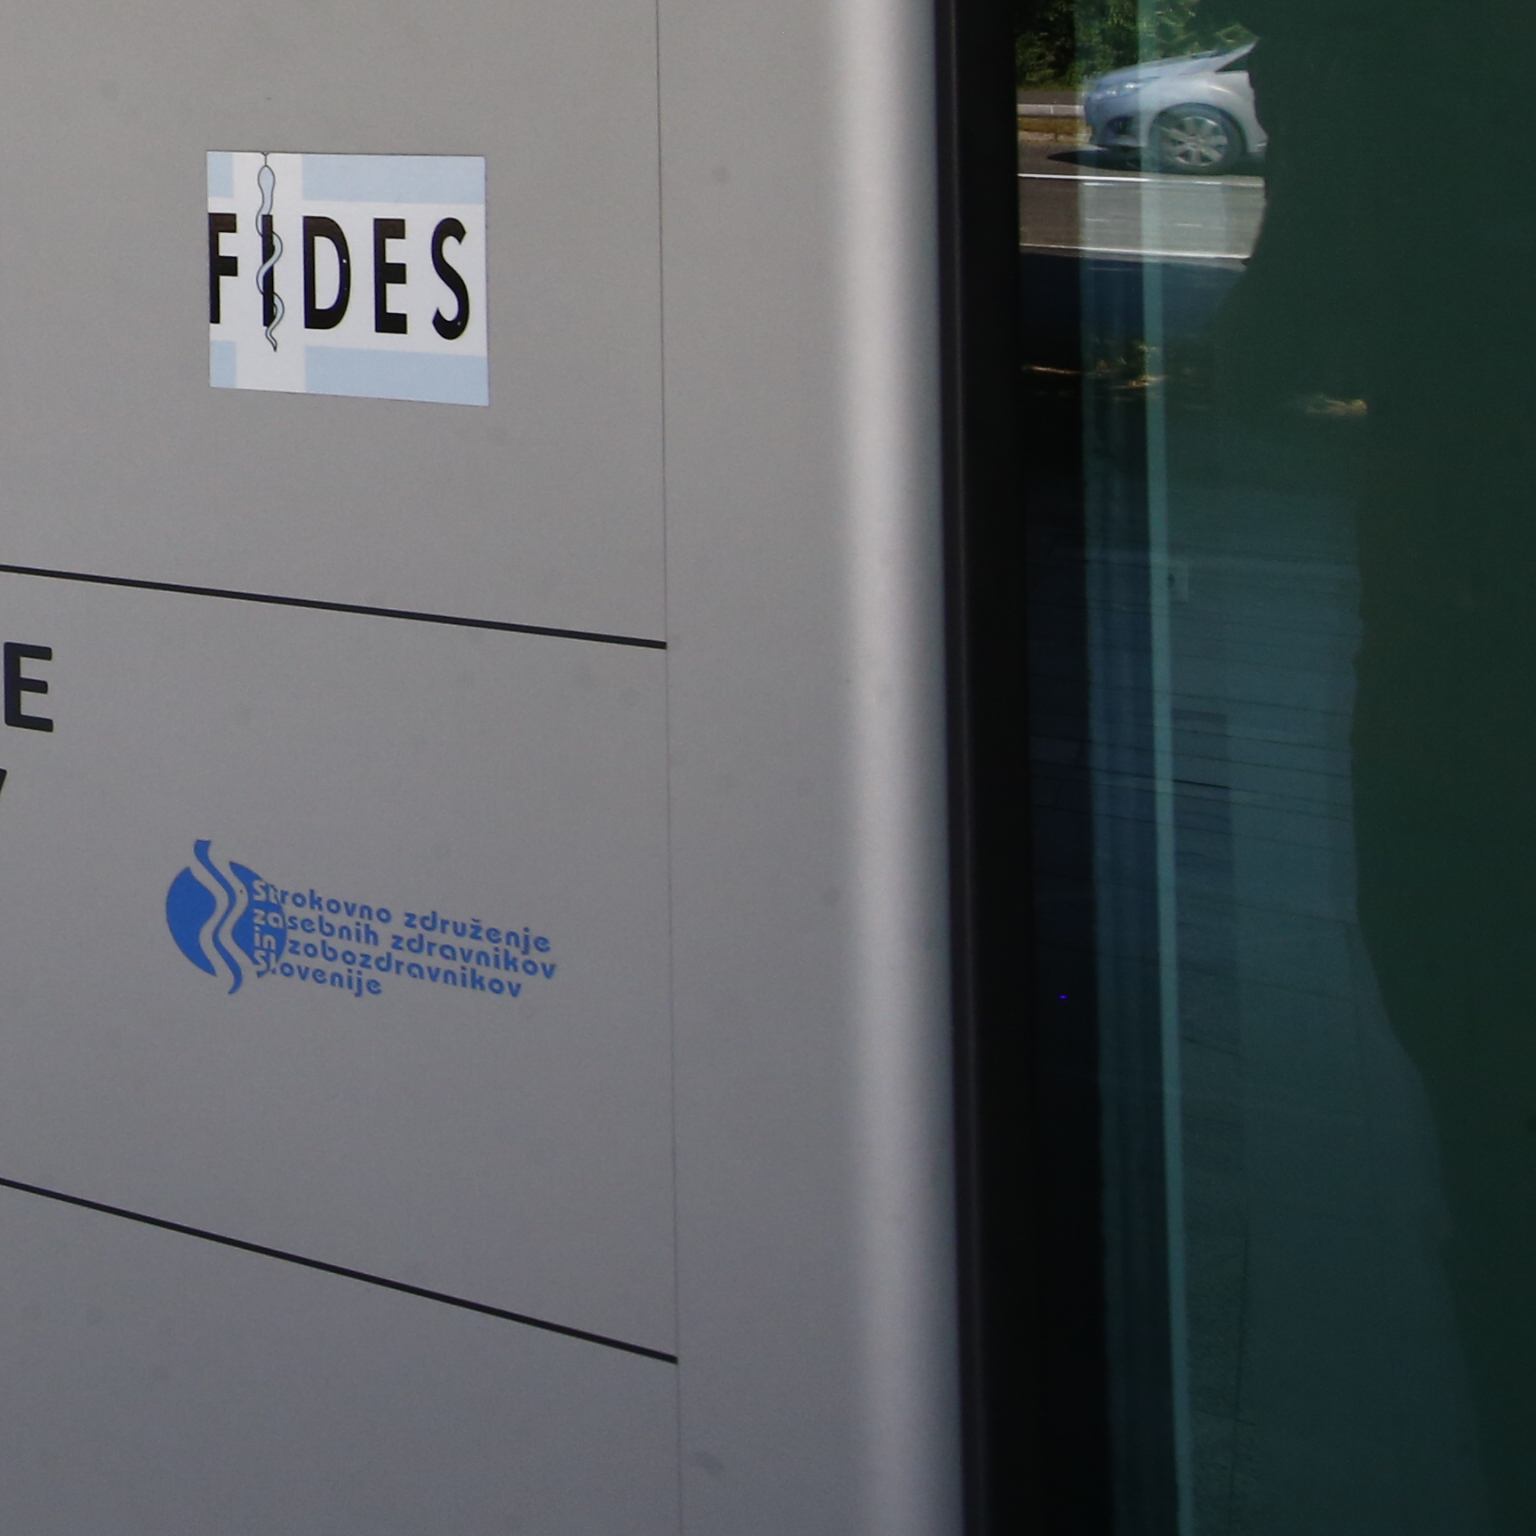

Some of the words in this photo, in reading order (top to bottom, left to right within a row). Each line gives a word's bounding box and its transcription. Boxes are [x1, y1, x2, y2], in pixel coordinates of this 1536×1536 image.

[208, 212, 470, 341] FIDES
[253, 879, 392, 923] Strokovno
[404, 911, 551, 955] združenje
[254, 908, 379, 946] zasebnih
[391, 933, 557, 979] zdravnikov
[254, 926, 277, 950] in
[288, 939, 522, 997] zobozdravnikov
[254, 949, 382, 997] Slovenije
